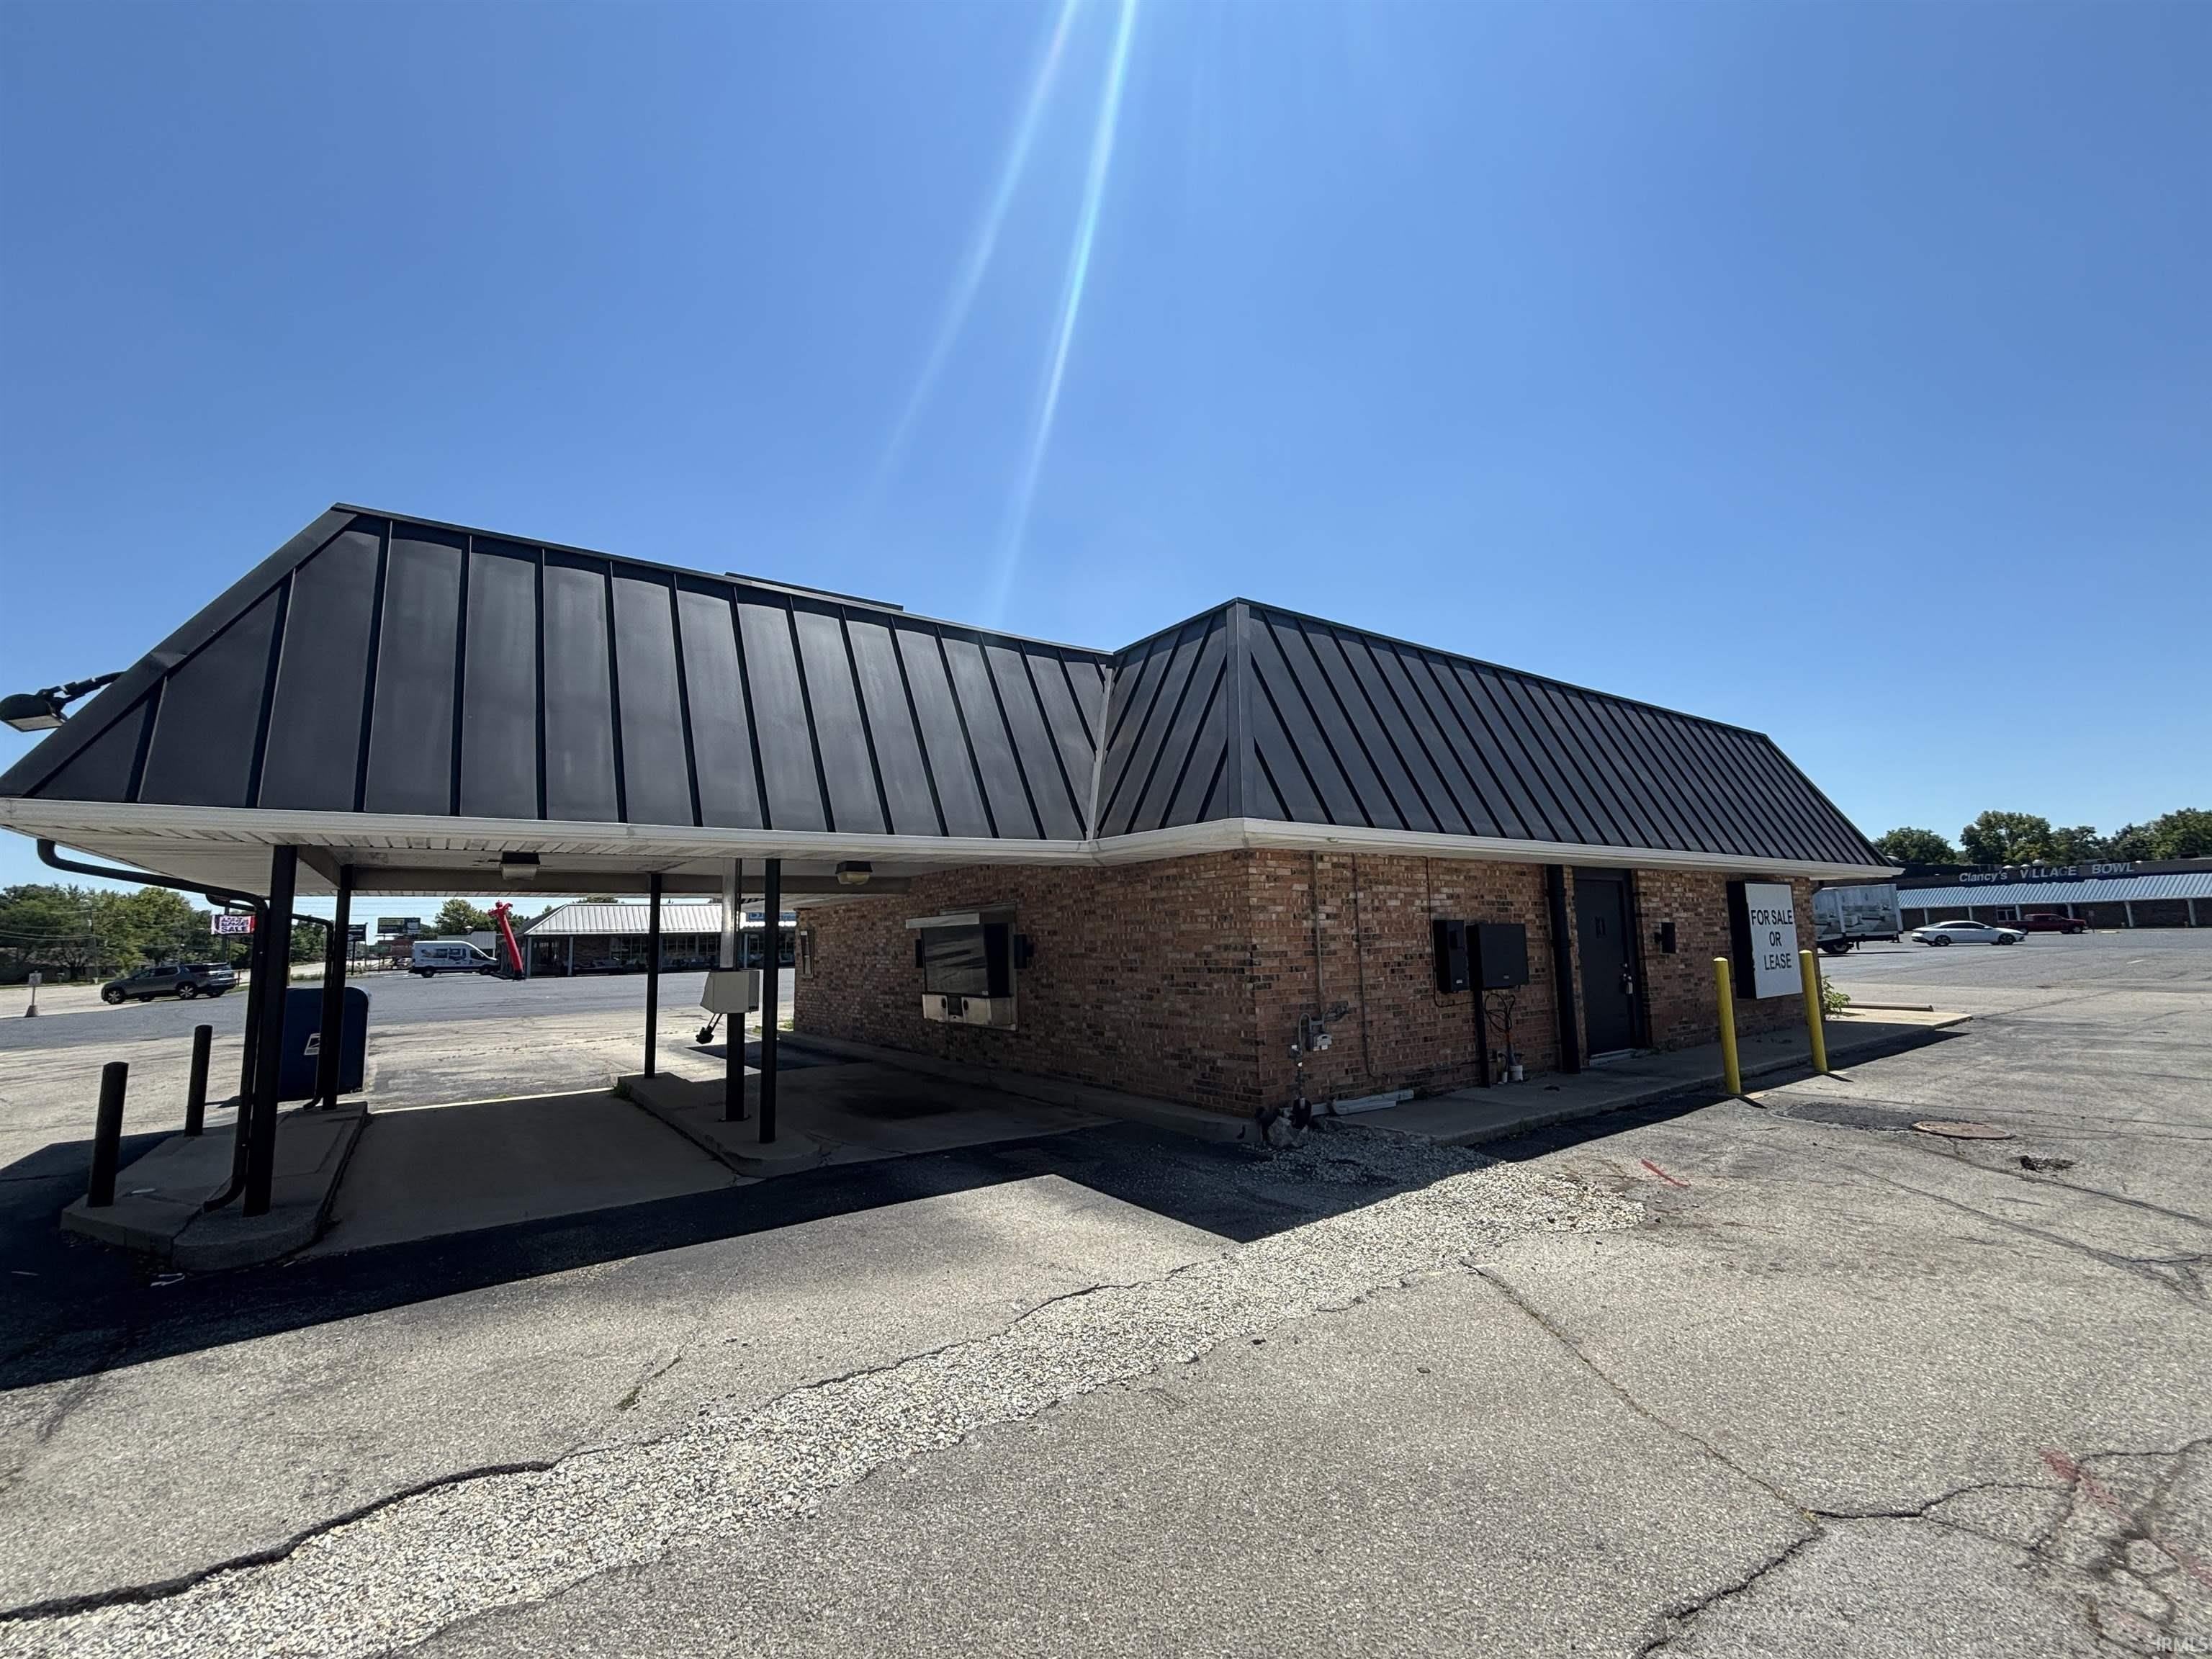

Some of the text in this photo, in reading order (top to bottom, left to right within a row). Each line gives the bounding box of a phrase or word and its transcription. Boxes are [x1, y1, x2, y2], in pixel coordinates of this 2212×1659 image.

[1959, 863, 2135, 882] Clancy's VILLAGE BOWL
[1750, 909, 1793, 925] FOR SALE
[1769, 930, 1782, 946] OR
[1763, 953, 1791, 970] LEASE
